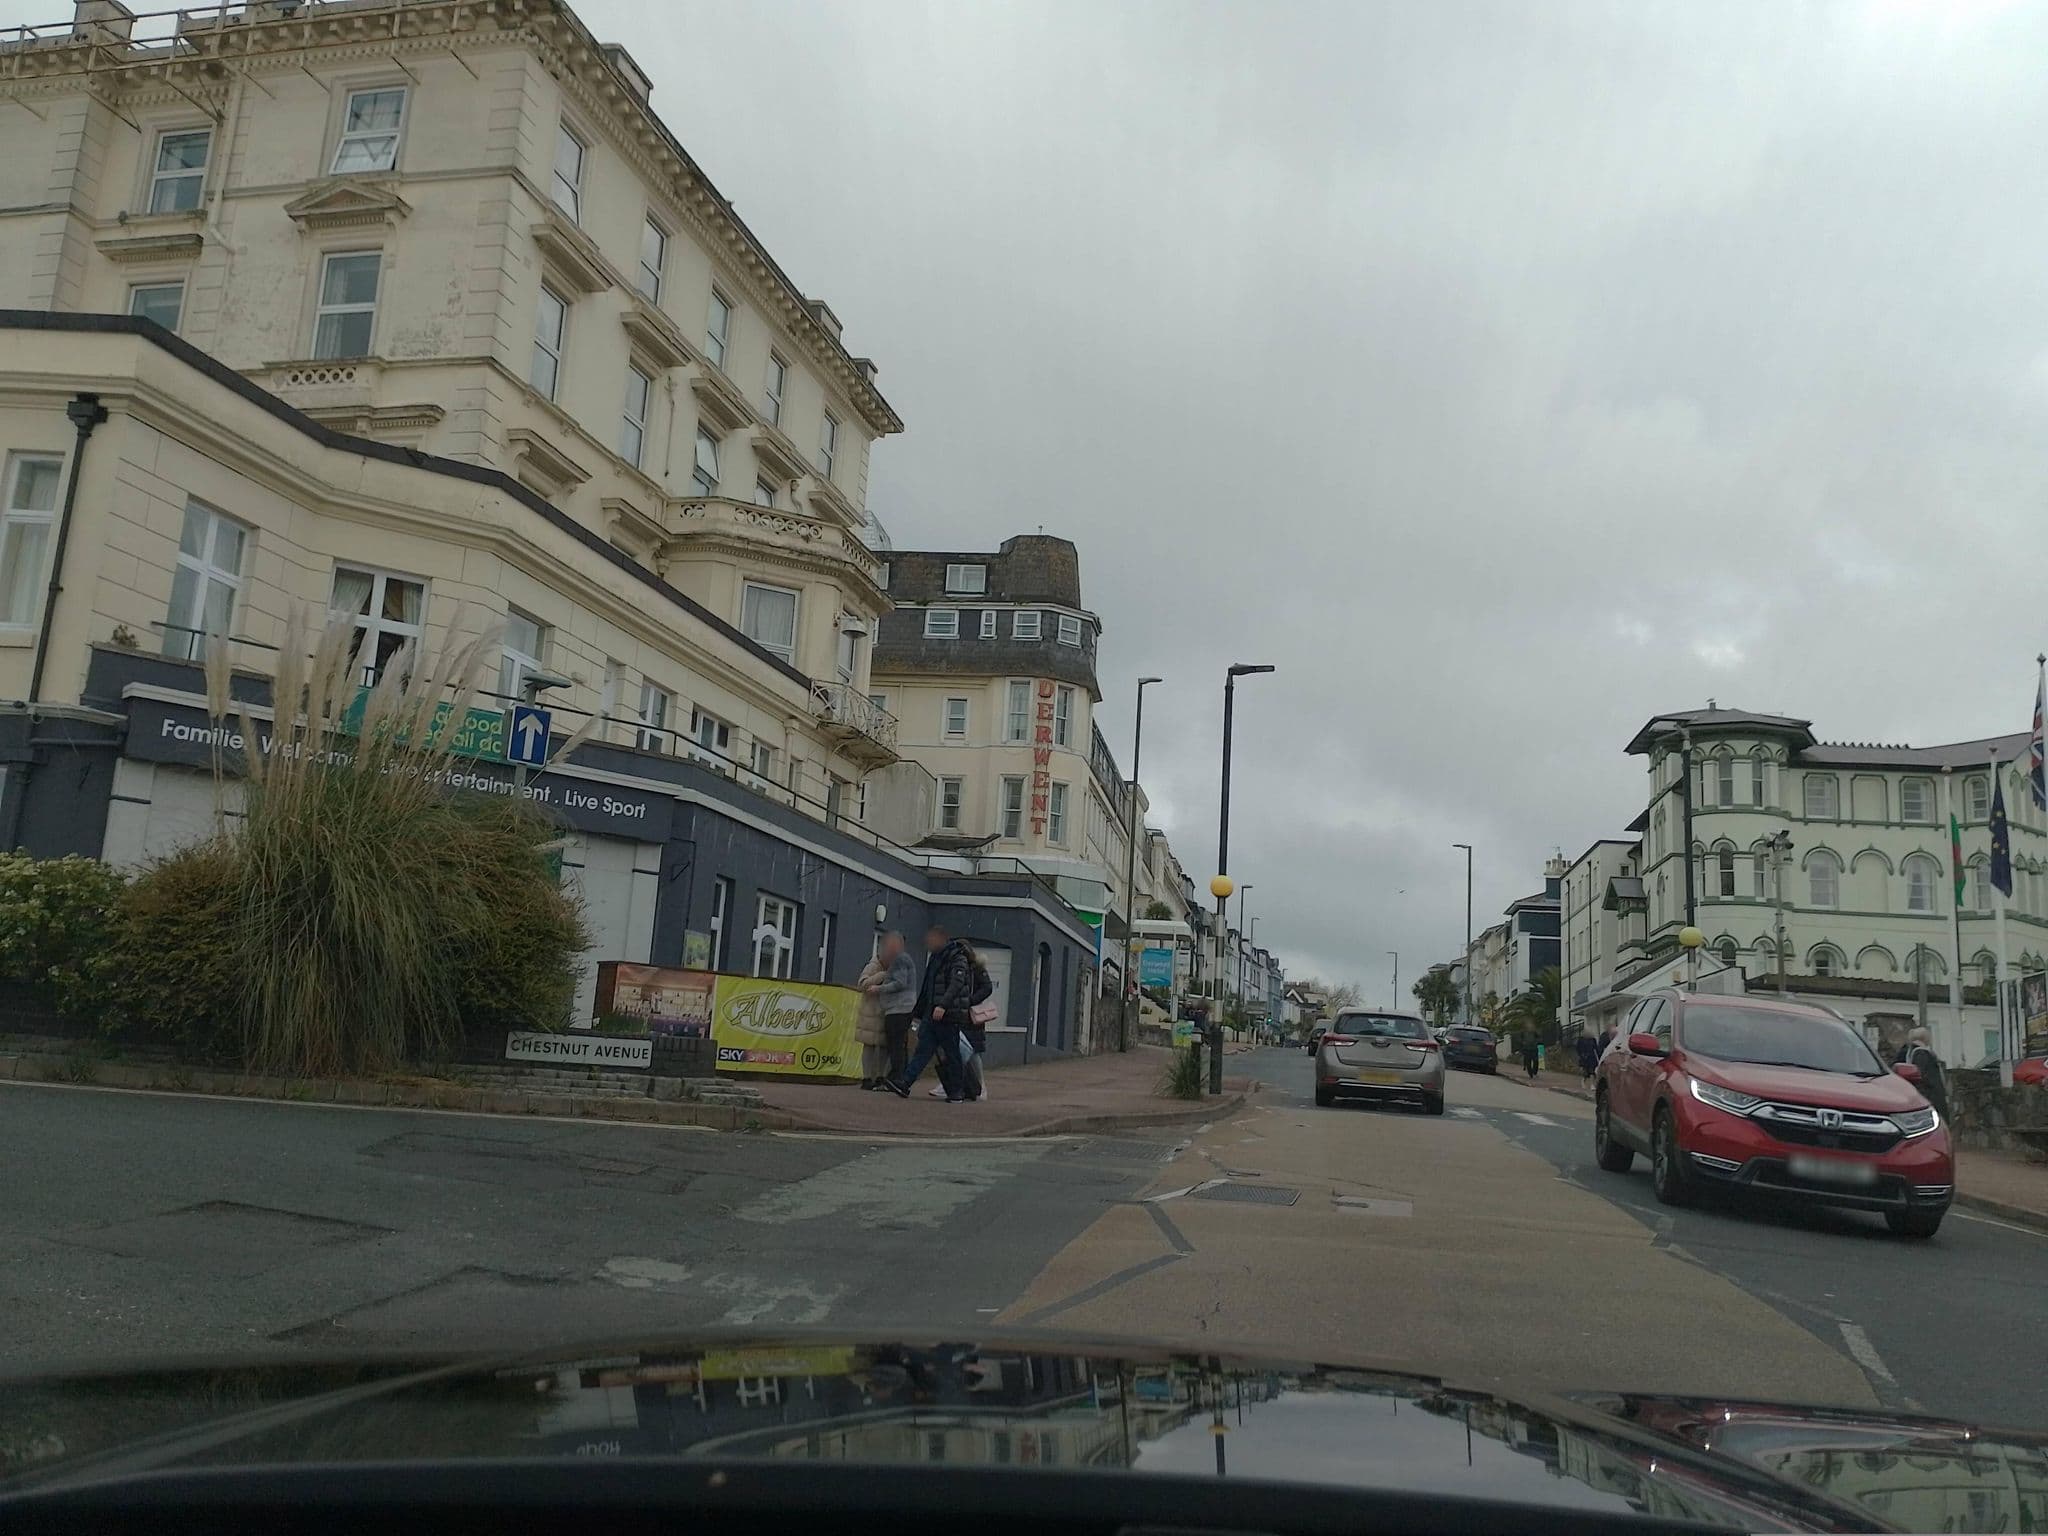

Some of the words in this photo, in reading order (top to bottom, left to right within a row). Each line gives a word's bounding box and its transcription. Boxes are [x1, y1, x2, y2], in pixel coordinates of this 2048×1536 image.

[480, 736, 502, 753] da
[1031, 679, 1056, 835] DERWENT
[161, 718, 249, 751] Familie
[564, 789, 599, 810] Live
[602, 796, 647, 819] Sport
[730, 990, 827, 1032] Alberts
[511, 1039, 590, 1056] CHESTNUT
[594, 1045, 649, 1060] AVENUE
[719, 1048, 744, 1061] SKY
